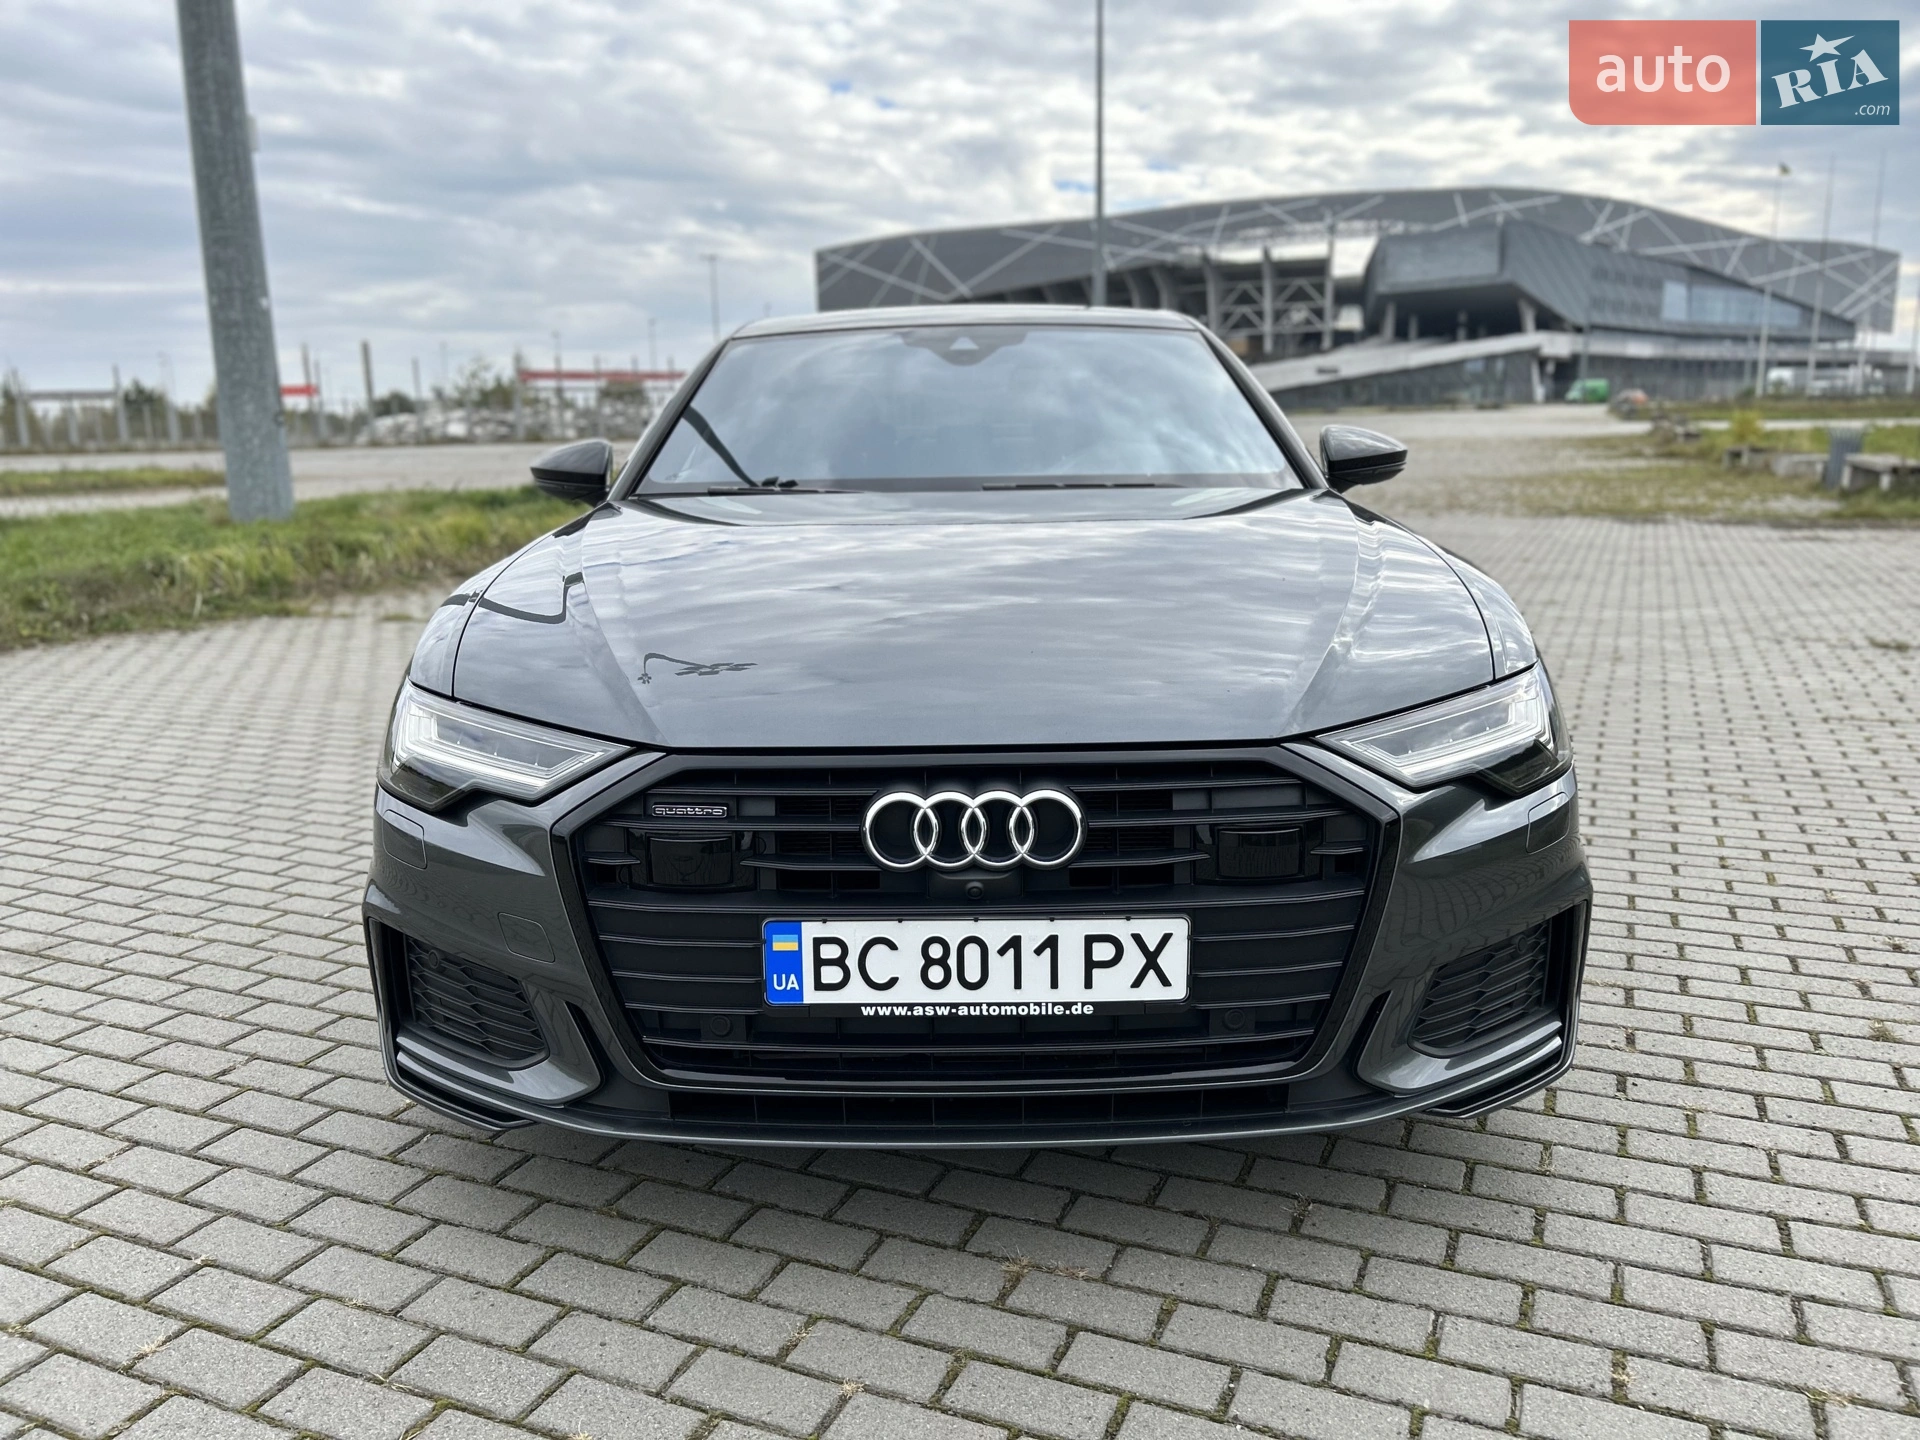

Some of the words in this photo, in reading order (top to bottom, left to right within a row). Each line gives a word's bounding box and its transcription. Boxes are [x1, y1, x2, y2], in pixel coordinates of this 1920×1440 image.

[655, 807, 723, 816] quattro
[812, 936, 899, 991] BC
[920, 934, 1059, 991] 8011
[1084, 932, 1174, 990] PX
[773, 973, 800, 991] UA
[861, 1003, 1094, 1016] www.asw-automobile.de
